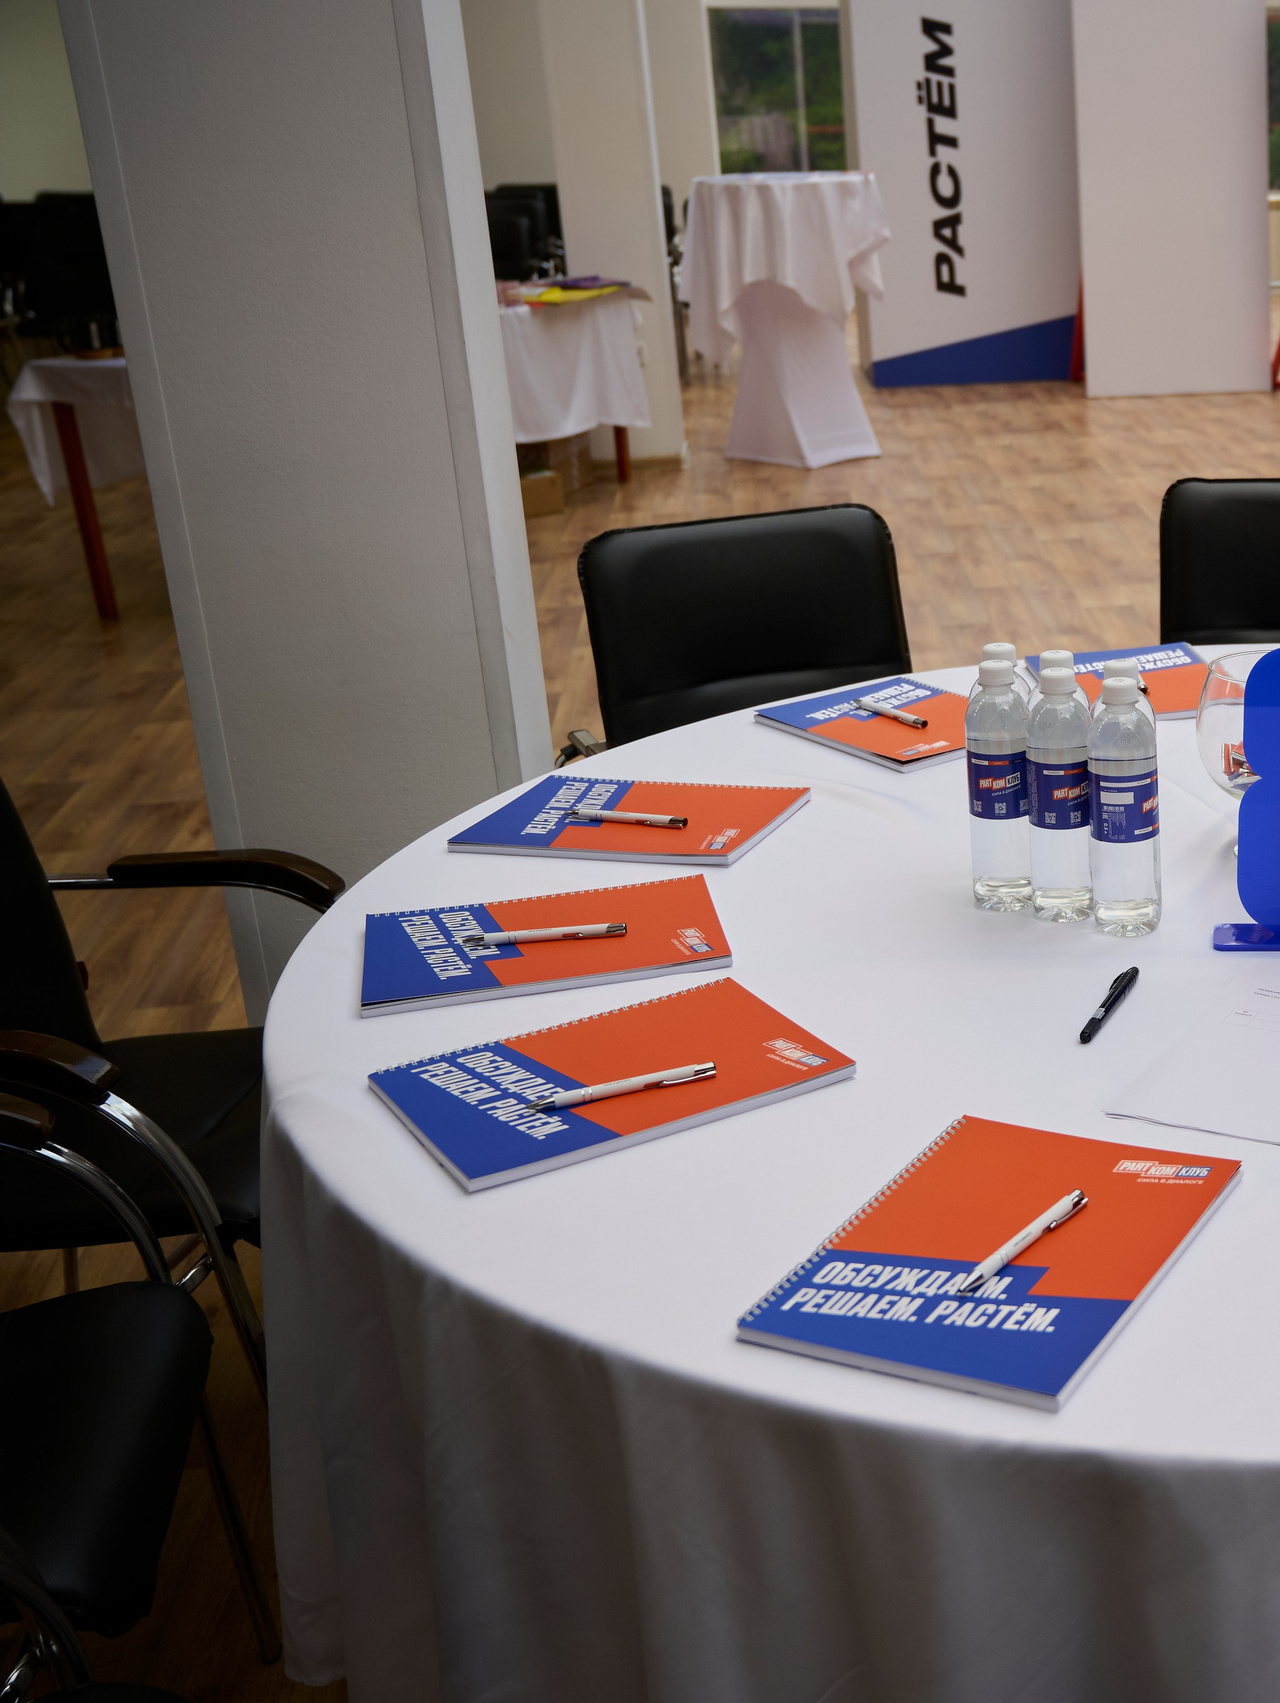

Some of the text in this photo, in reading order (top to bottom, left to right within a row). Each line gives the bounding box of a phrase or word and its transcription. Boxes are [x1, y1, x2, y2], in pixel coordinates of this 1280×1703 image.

[915, 17, 967, 297] РАСТЁМ
[398, 915, 449, 950] РЕШАЕМ.
[410, 1061, 502, 1106] РЕШАЕМ.
[1178, 1166, 1210, 1177] КЛУБ
[812, 1260, 1014, 1300] ОБСУЖДАМ.
[780, 1287, 1061, 1333] РЕШАЕМ. РАСТЁМ.
